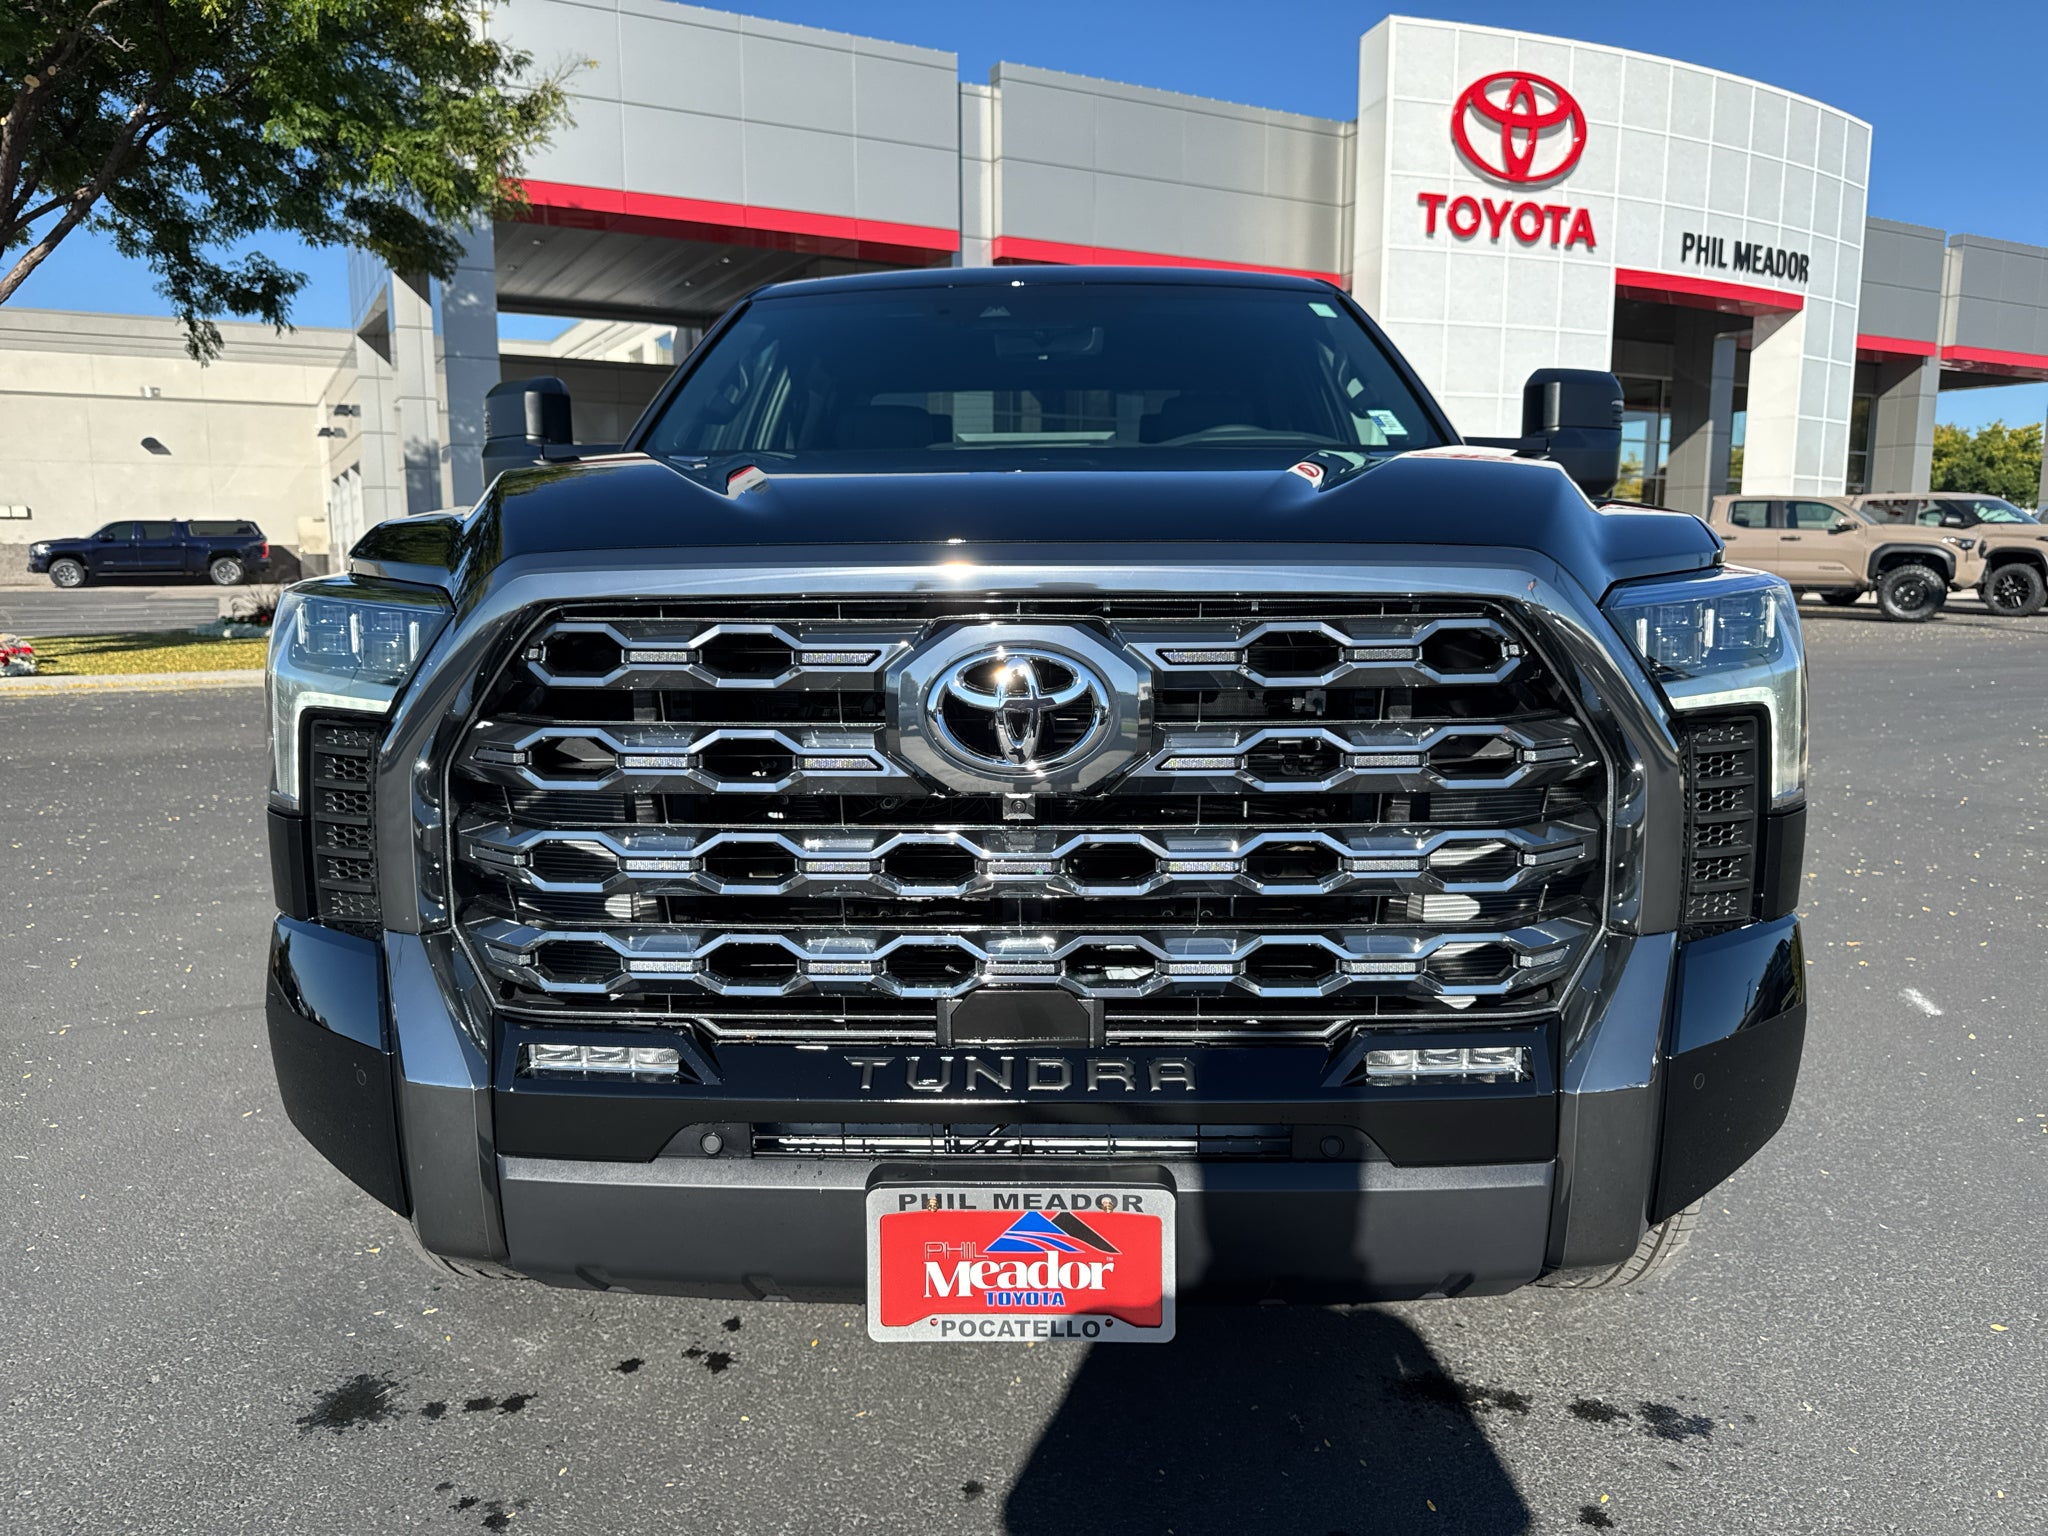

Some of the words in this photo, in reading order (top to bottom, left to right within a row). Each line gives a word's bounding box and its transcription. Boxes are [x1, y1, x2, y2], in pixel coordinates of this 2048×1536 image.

[1418, 192, 1597, 250] TOYOTA
[1681, 231, 1727, 270] PHIL
[1733, 240, 1810, 284] MEADOR
[844, 1056, 1196, 1093] TUNDRA
[898, 1193, 976, 1211] PHIL
[993, 1193, 1144, 1213] MEADOR
[924, 1241, 989, 1260] PHIL
[923, 1251, 1114, 1298] Meador
[985, 1291, 1066, 1307] TOYOTA
[941, 1319, 1101, 1339] POCATELLO
